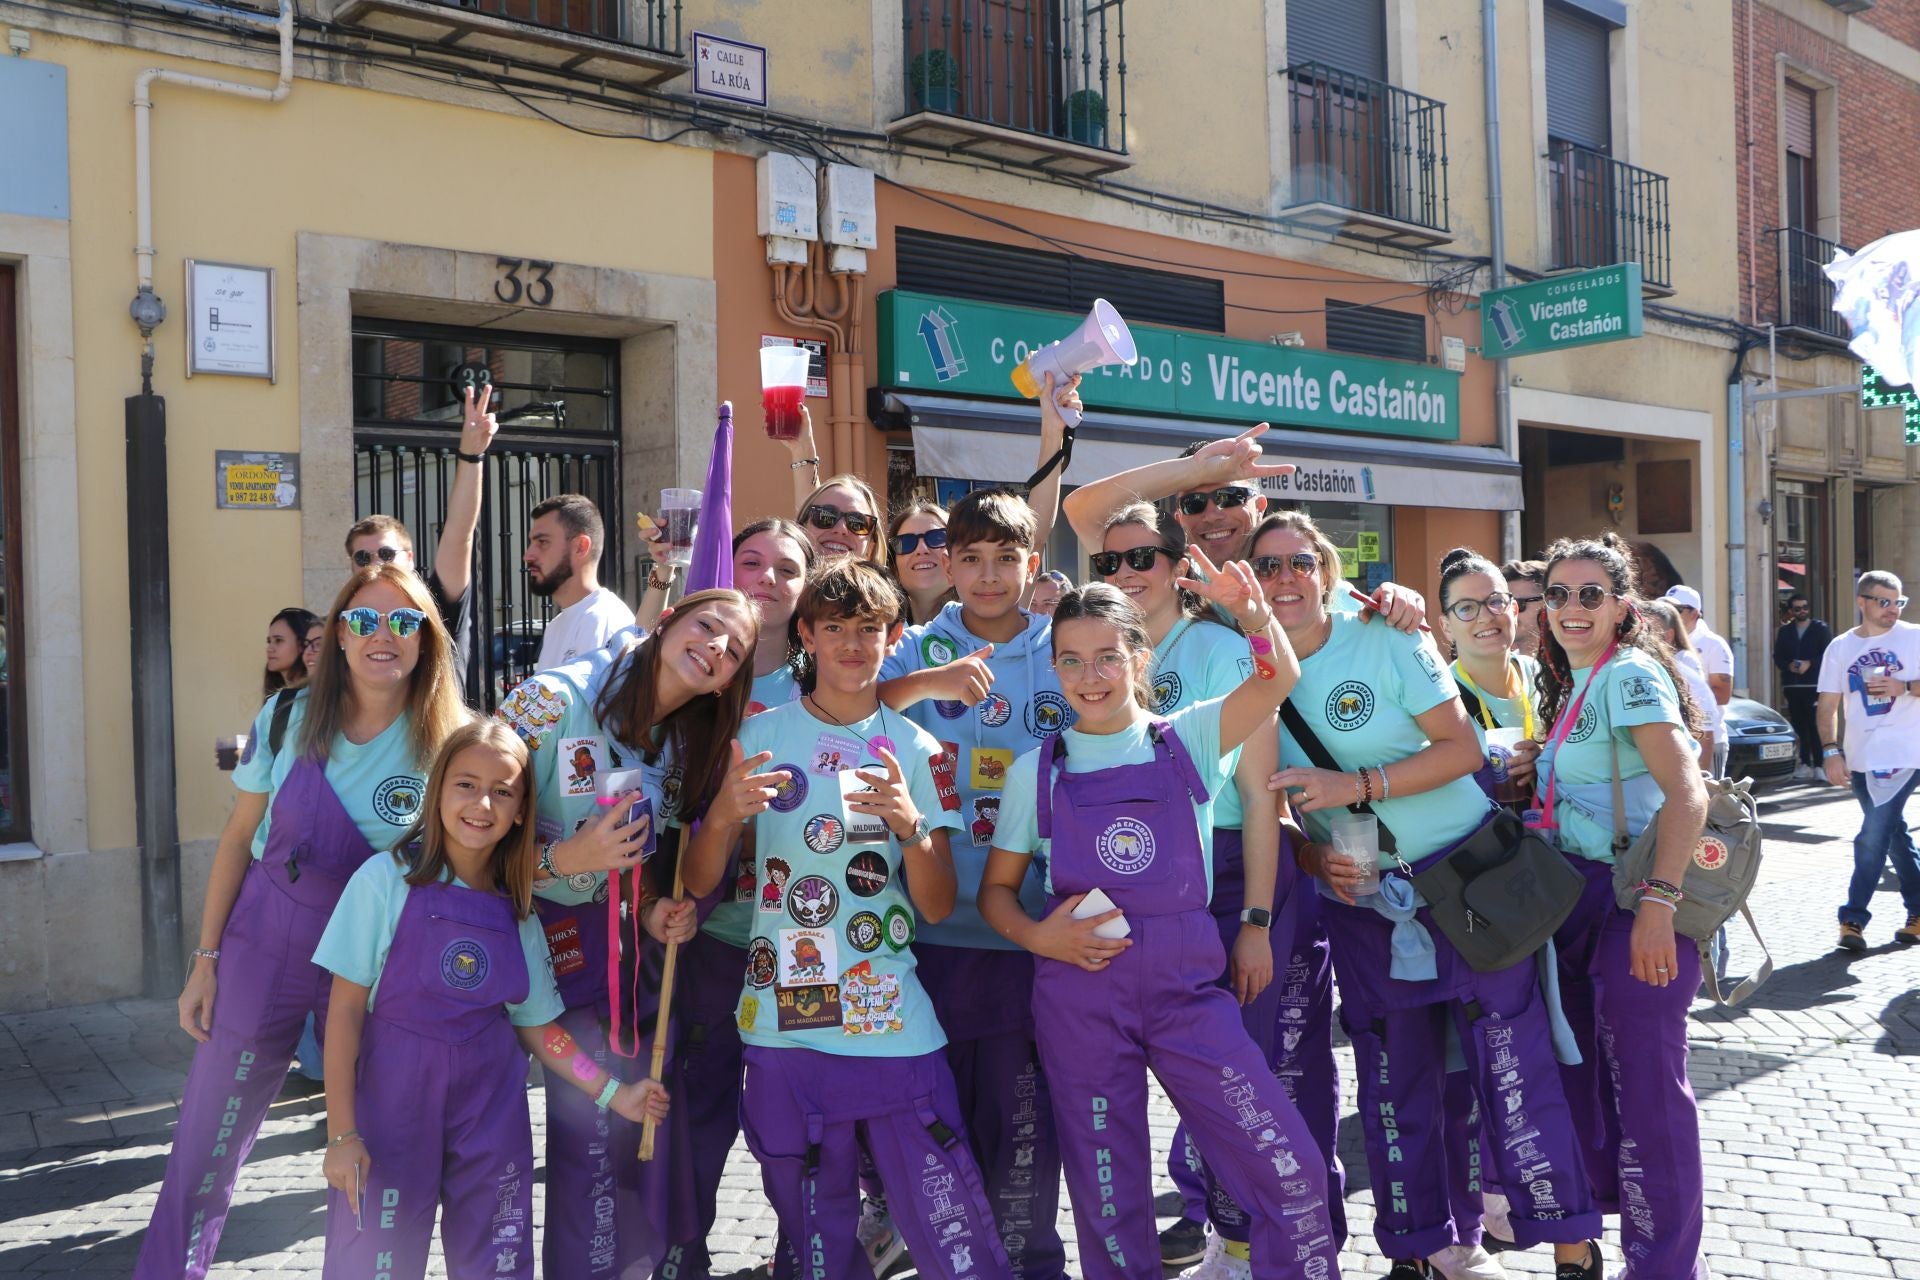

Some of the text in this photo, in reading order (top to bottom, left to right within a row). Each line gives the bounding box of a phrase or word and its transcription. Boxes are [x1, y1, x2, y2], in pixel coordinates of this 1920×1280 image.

[717, 50, 744, 66] CALLE
[712, 70, 750, 91] LA RÚA
[494, 256, 553, 306] 33
[1547, 274, 1621, 296] CONGELADOS
[1529, 296, 1589, 322] Vicente
[1550, 312, 1622, 341] Castañón
[1207, 352, 1321, 411] Vicente
[1329, 369, 1446, 425] Castañón
[1294, 466, 1356, 494] Castañón
[1104, 821, 1122, 836] KOPA
[1134, 824, 1150, 842] KOPA
[1101, 847, 1152, 871] VALDUVIECO
[777, 985, 838, 1008] 30 12
[800, 1015, 836, 1024] MAGDALENOS
[235, 1051, 256, 1081] DE
[211, 1096, 243, 1157] KOPA
[1379, 1101, 1403, 1162] KOPA
[1391, 1181, 1407, 1214] EN
[1468, 1138, 1481, 1192] KOPA
[1092, 1097, 1127, 1268] DE KOPA EN
[381, 1188, 400, 1229] DE
